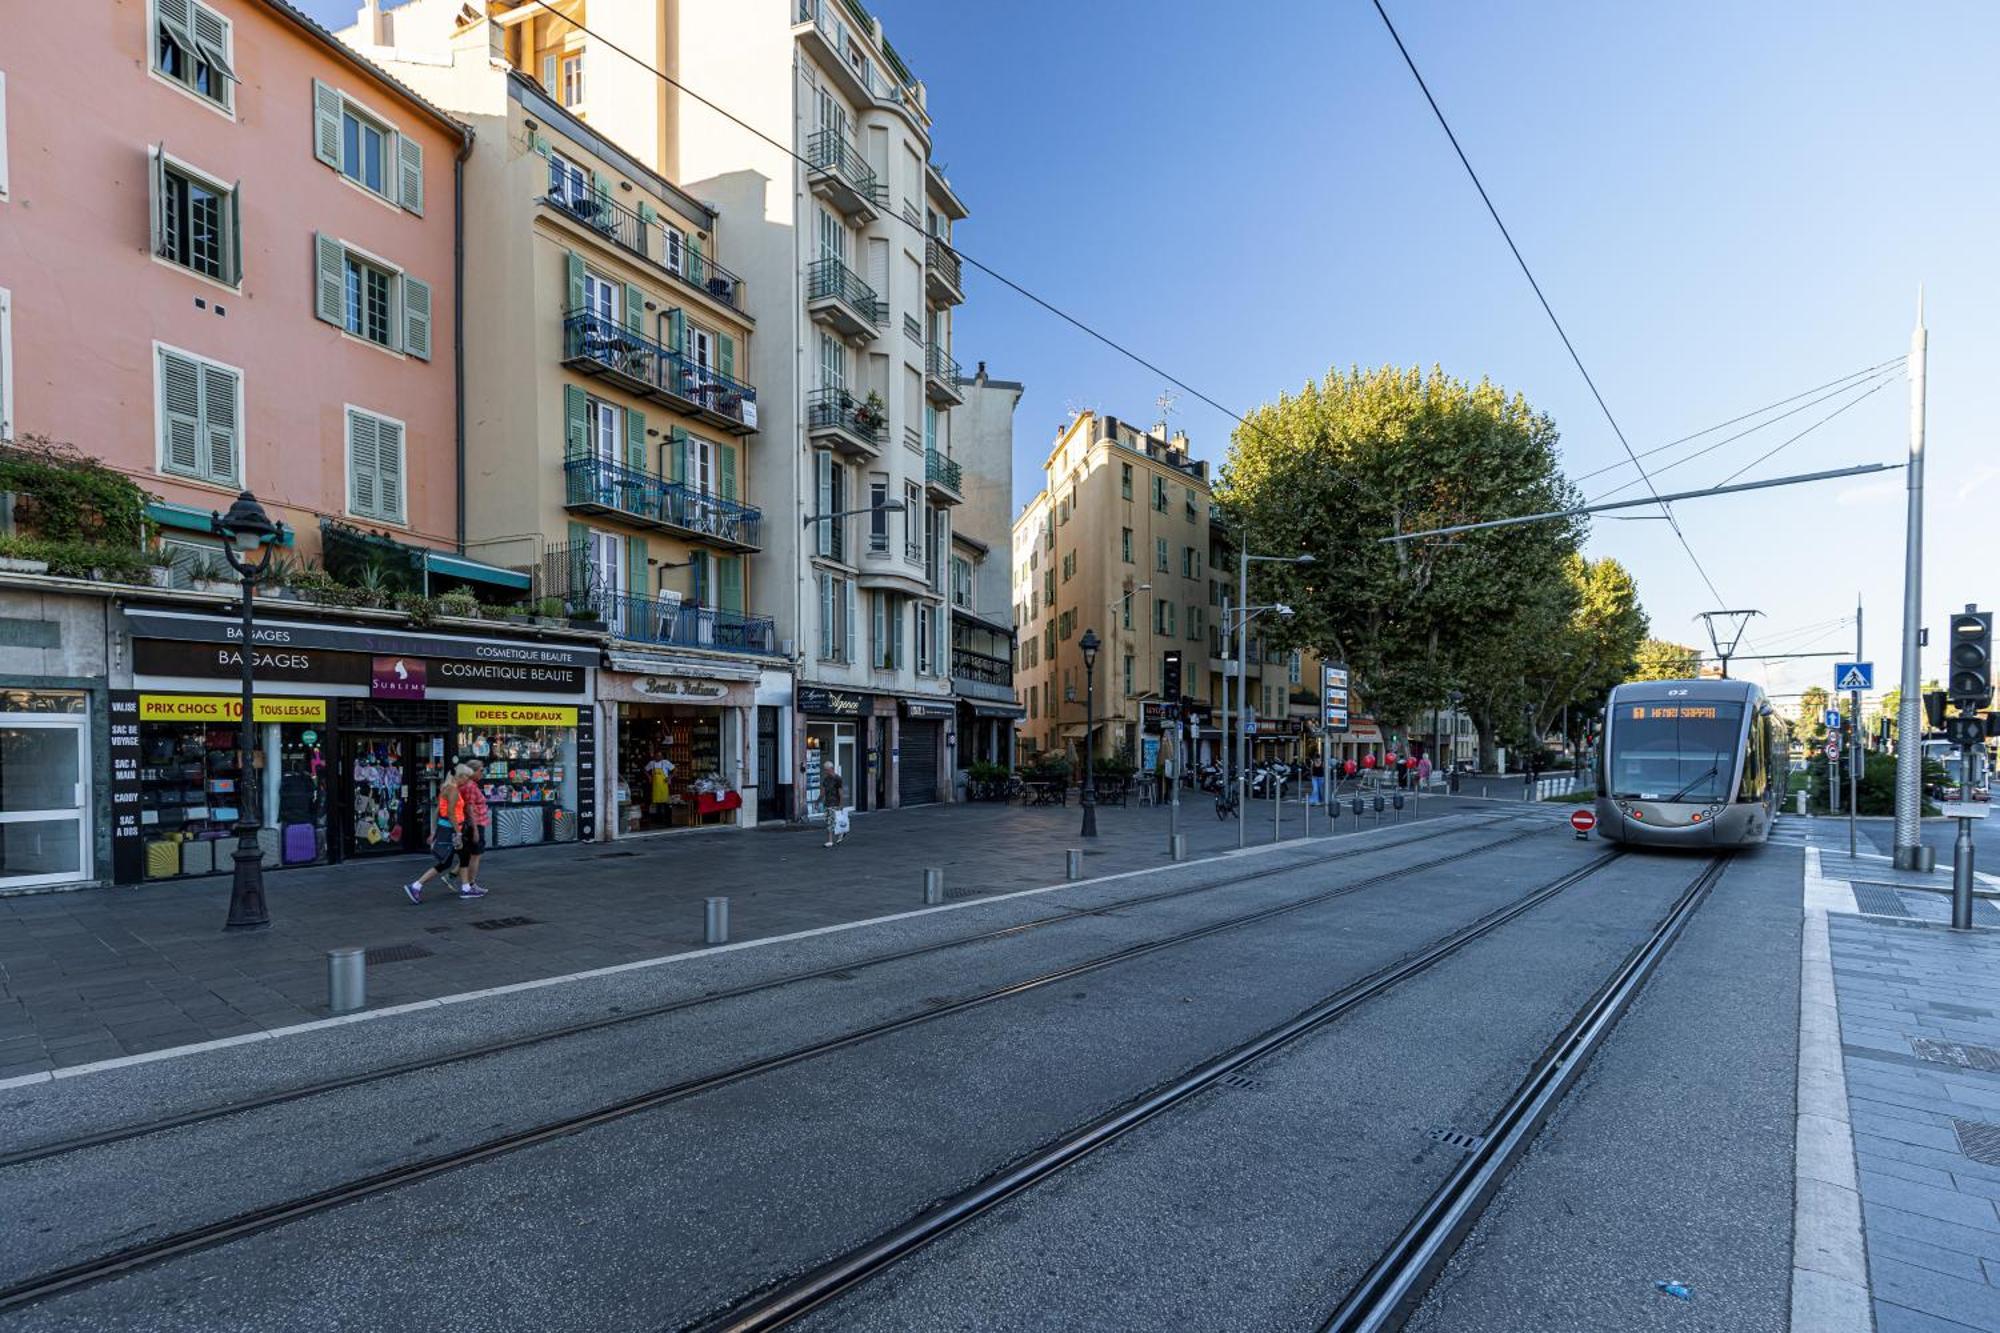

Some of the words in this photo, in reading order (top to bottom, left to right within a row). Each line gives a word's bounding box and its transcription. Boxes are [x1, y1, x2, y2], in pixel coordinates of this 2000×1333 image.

[476, 646, 538, 660] COSMETIQUE
[541, 651, 572, 662] BEAUTE
[441, 663, 527, 680] COSMETIQUE
[531, 668, 574, 682] BEAUTE
[146, 703, 174, 714] PRIX
[177, 704, 217, 714] CHOCS
[260, 704, 283, 716] TOUS
[284, 705, 299, 716] LES
[300, 706, 321, 716] SACS
[475, 710, 508, 720] IDEES
[511, 711, 562, 721] CADEAUX
[111, 725, 127, 735] SAC
[114, 759, 130, 769] SAC
[120, 815, 134, 826] SAC
